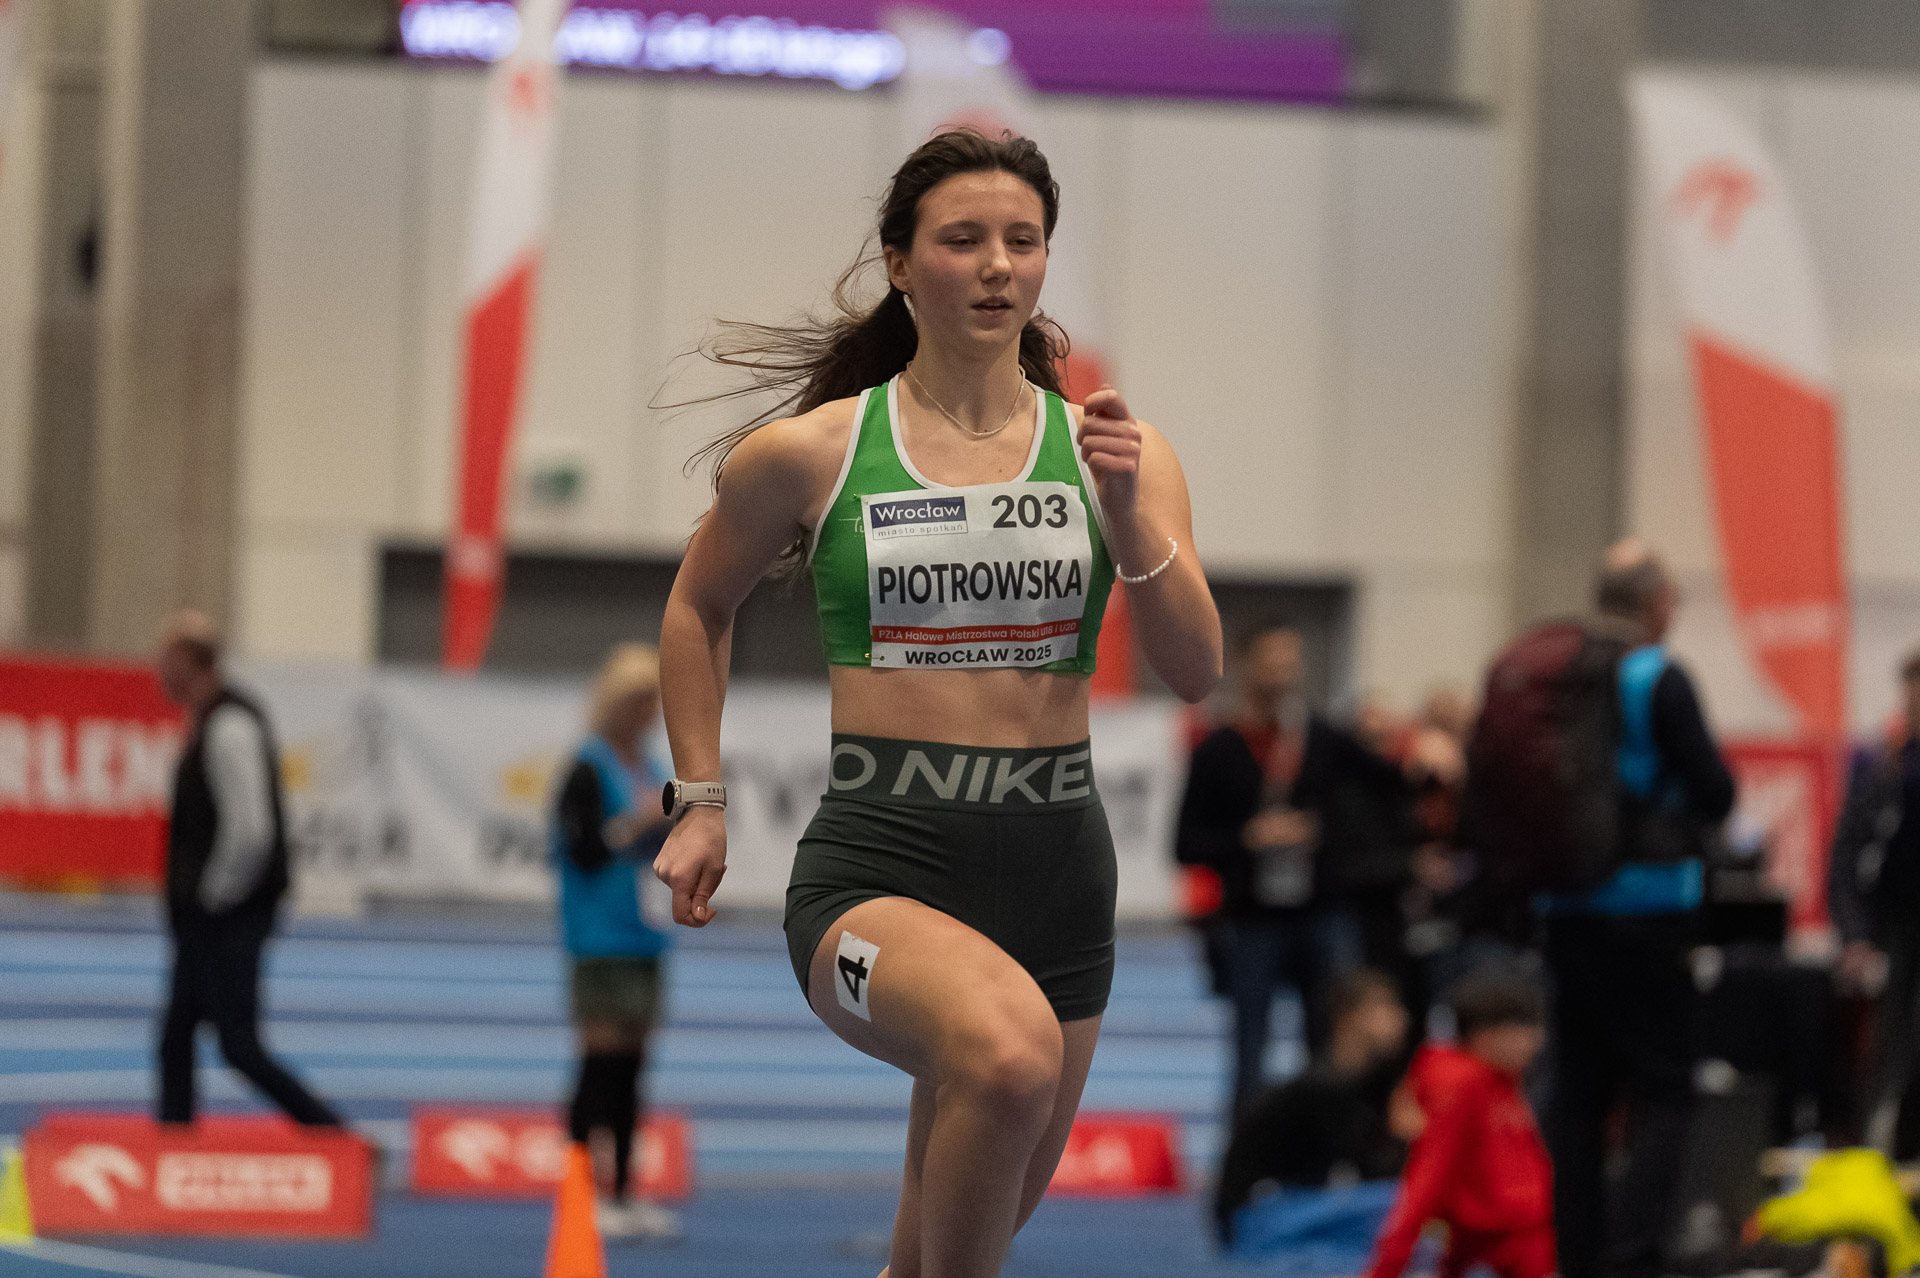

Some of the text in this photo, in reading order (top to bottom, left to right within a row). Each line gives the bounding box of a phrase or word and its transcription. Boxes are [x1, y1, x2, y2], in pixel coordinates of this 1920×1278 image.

[875, 502, 960, 522] Wrocław
[991, 494, 1068, 529] 203
[877, 523, 963, 537] miasto spotkań
[878, 559, 1082, 604] PIOTROWSKA
[878, 629, 903, 640] PZLA
[905, 631, 944, 642] Halowe
[946, 628, 1007, 641] Mistrzostwa
[1010, 627, 1040, 639] Polski
[1059, 622, 1077, 633] U20
[904, 644, 1052, 666] WROCŁAW 2025
[889, 749, 1091, 804] NIKE
[837, 955, 869, 1004] 4
